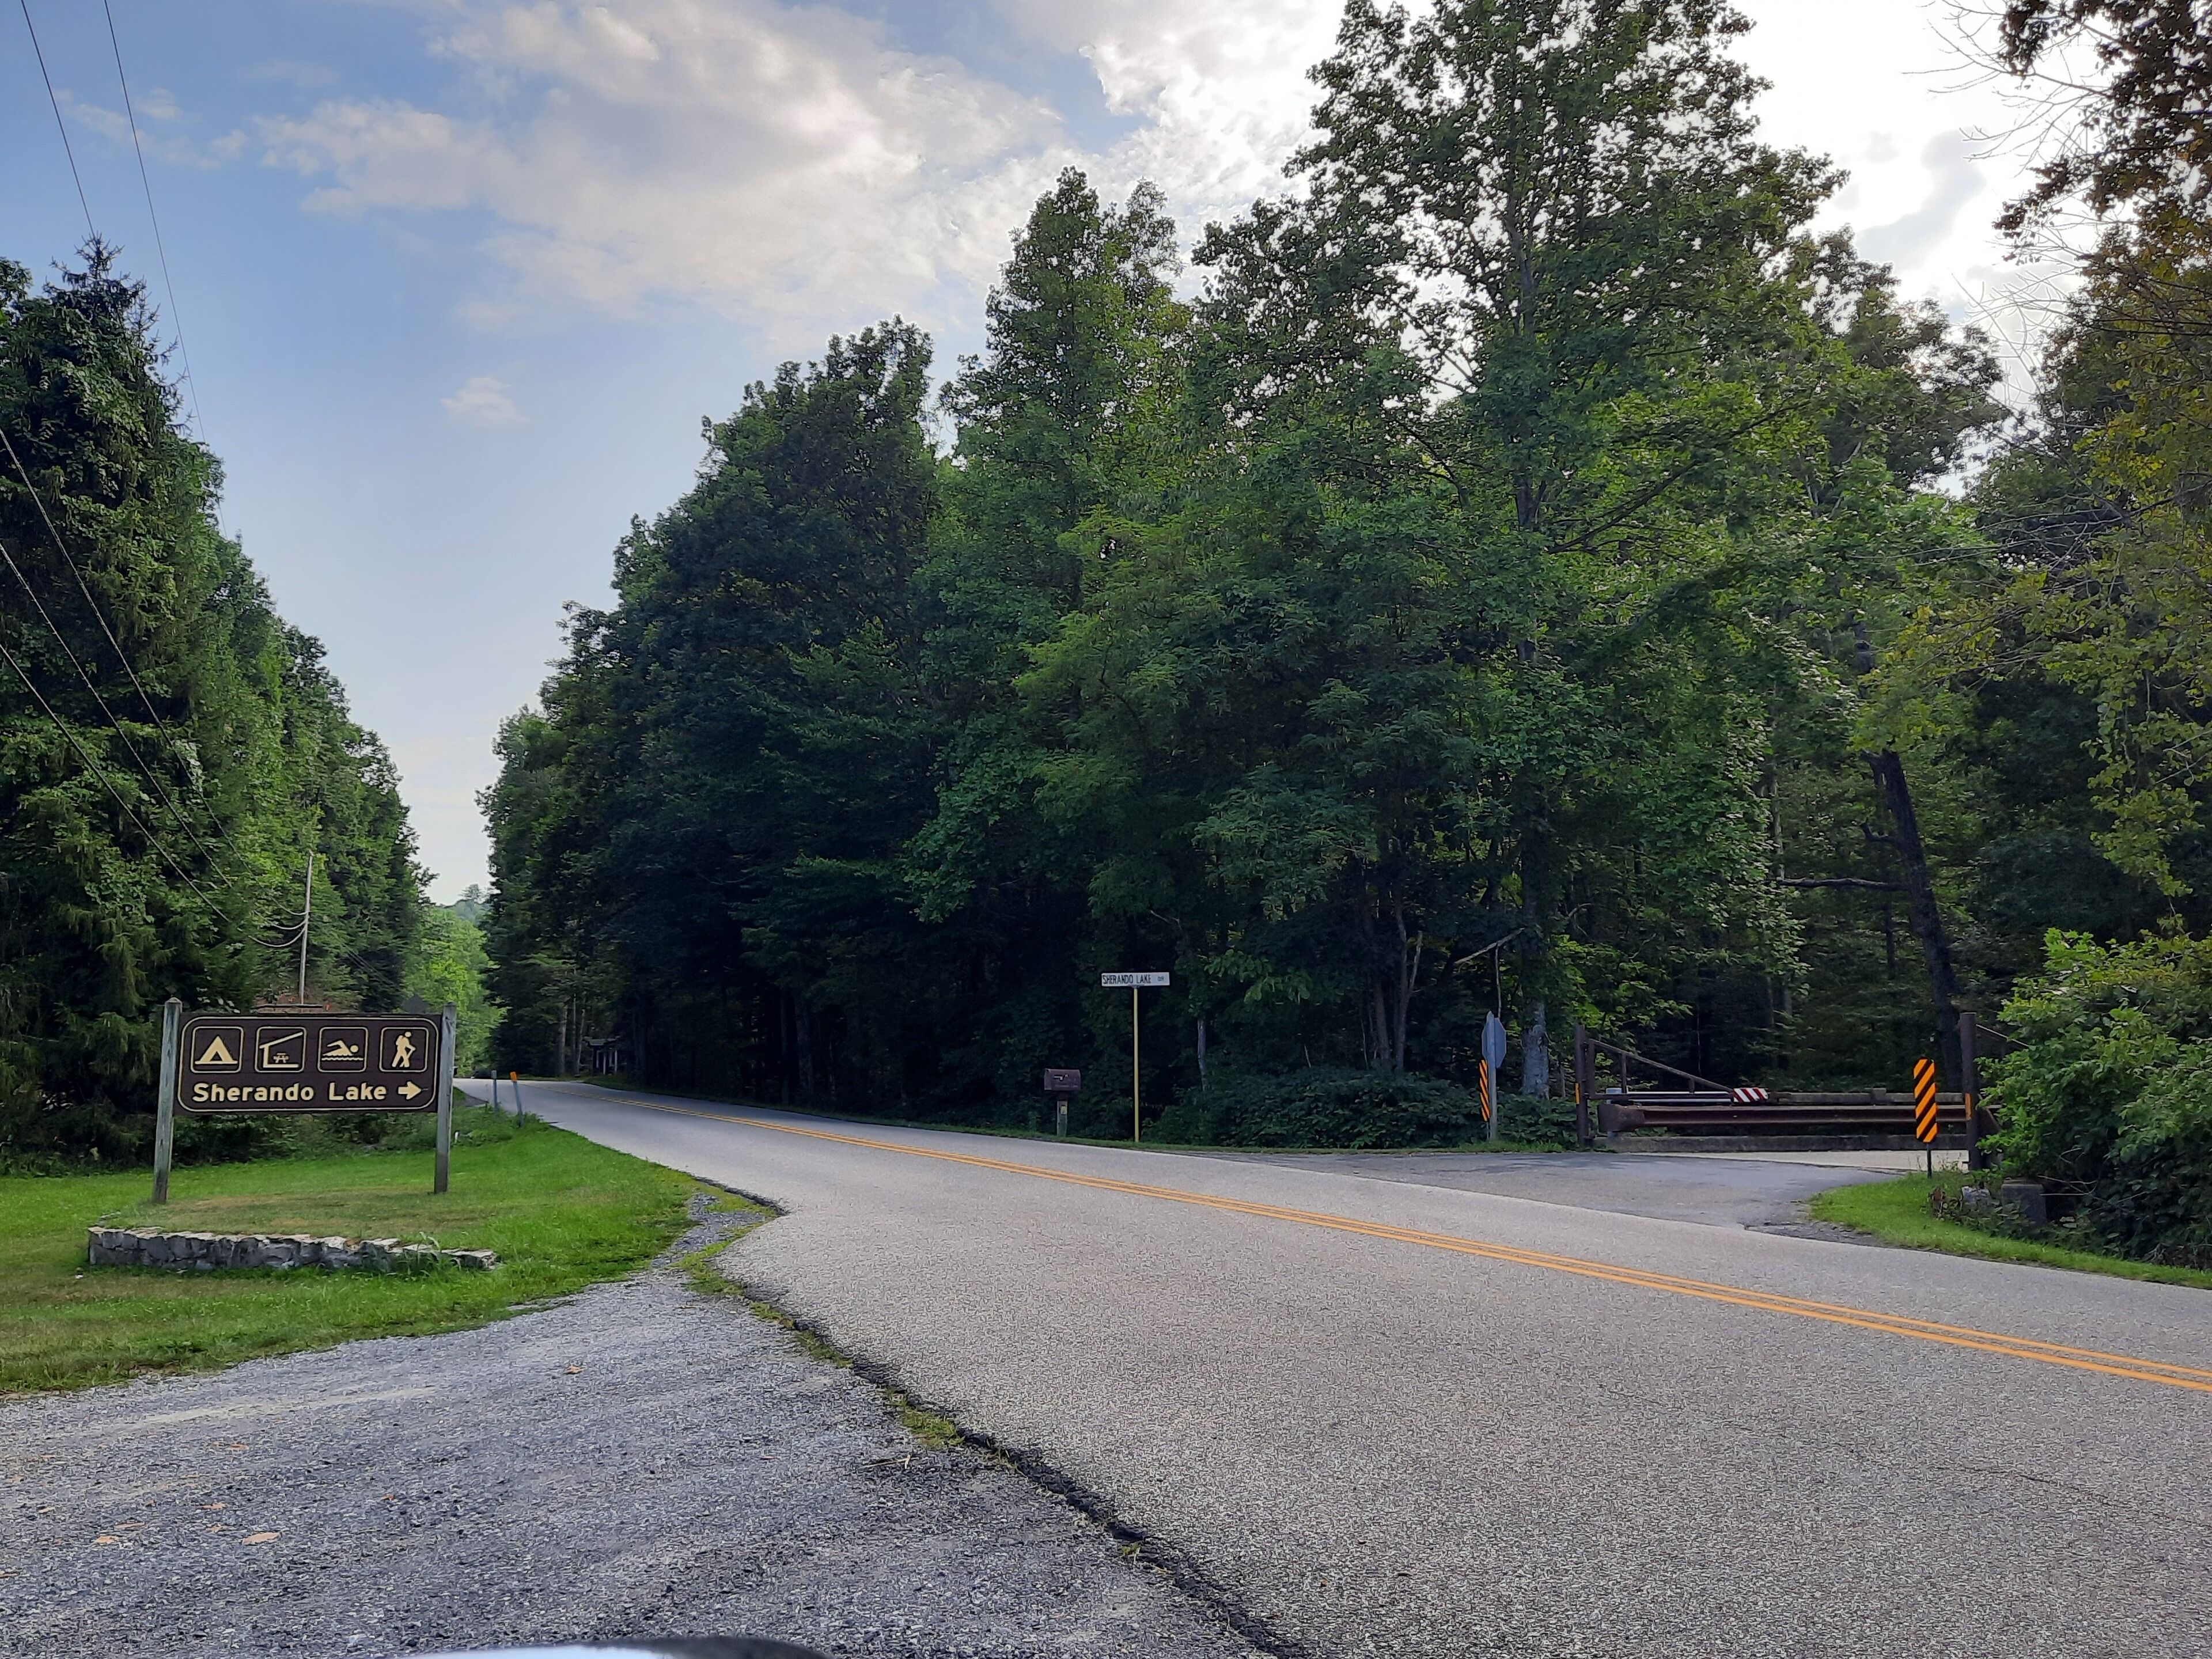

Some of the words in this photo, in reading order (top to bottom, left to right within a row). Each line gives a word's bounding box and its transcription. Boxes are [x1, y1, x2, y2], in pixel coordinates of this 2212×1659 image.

[1103, 975, 1133, 984] SHERANDO
[1137, 974, 1151, 983] LAKE
[192, 1082, 315, 1102] Sherando
[329, 1082, 387, 1101] Lake
